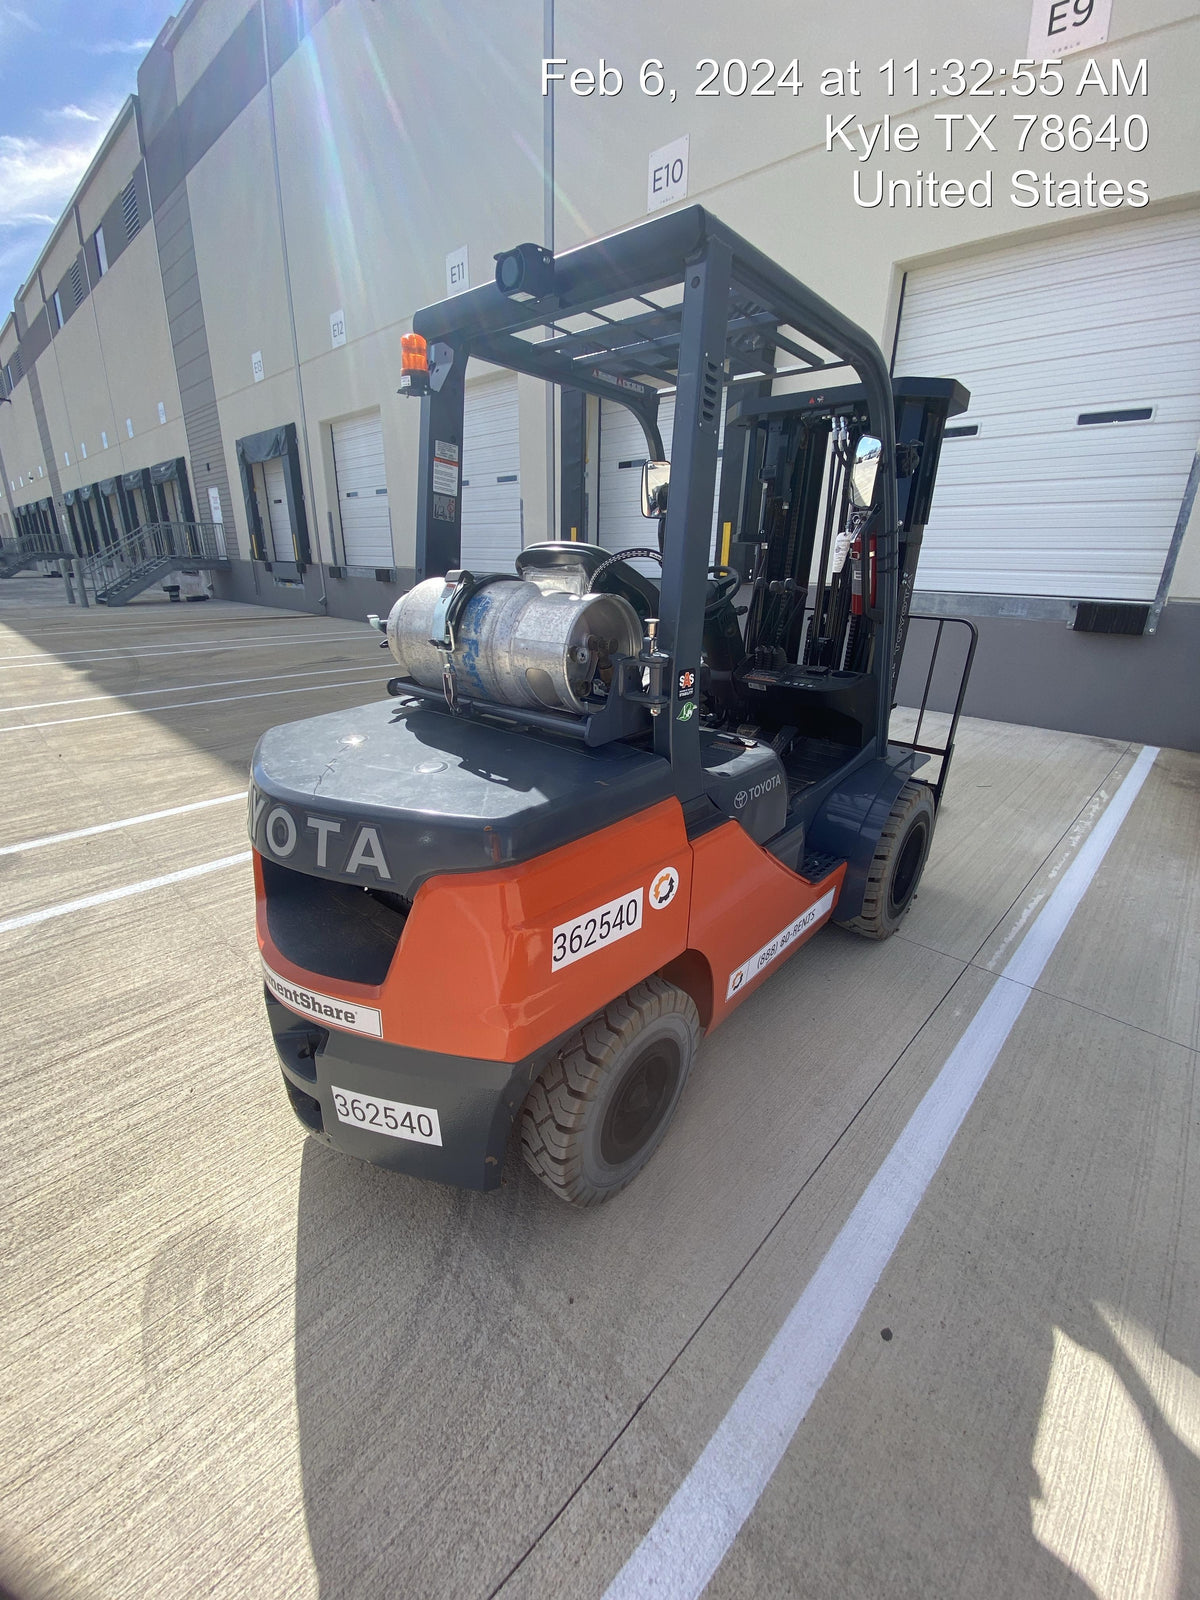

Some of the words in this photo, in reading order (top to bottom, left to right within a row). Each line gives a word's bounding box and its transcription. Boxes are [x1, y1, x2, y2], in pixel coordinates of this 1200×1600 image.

[1048, 0, 1094, 36] E9
[653, 158, 684, 193] E10
[450, 261, 465, 284] E11
[332, 320, 344, 338] E12
[748, 774, 782, 801] TOYOTA
[251, 788, 392, 880] YOTA
[553, 898, 638, 963] 362540
[757, 941, 779, 969] (888)
[267, 976, 356, 1024] mentShare
[334, 1093, 434, 1137] 362540
